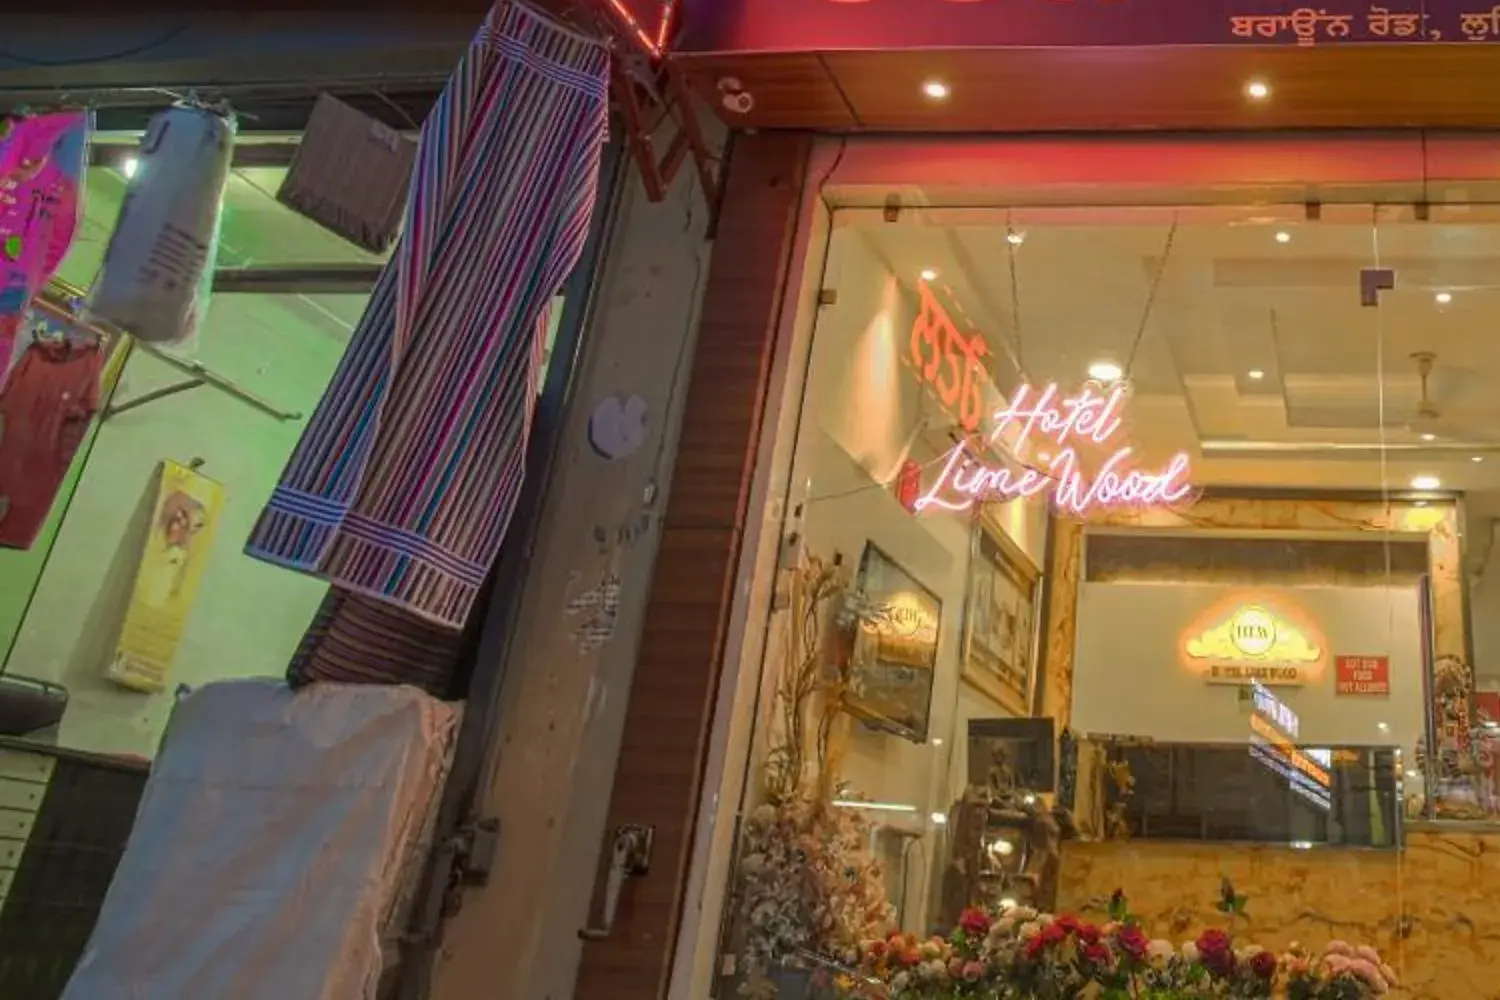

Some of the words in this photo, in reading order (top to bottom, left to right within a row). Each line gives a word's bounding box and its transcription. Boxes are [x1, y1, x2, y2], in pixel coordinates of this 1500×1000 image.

[991, 382, 1125, 456] Hotel
[914, 438, 1052, 516] Lime
[1048, 446, 1194, 511] Wood
